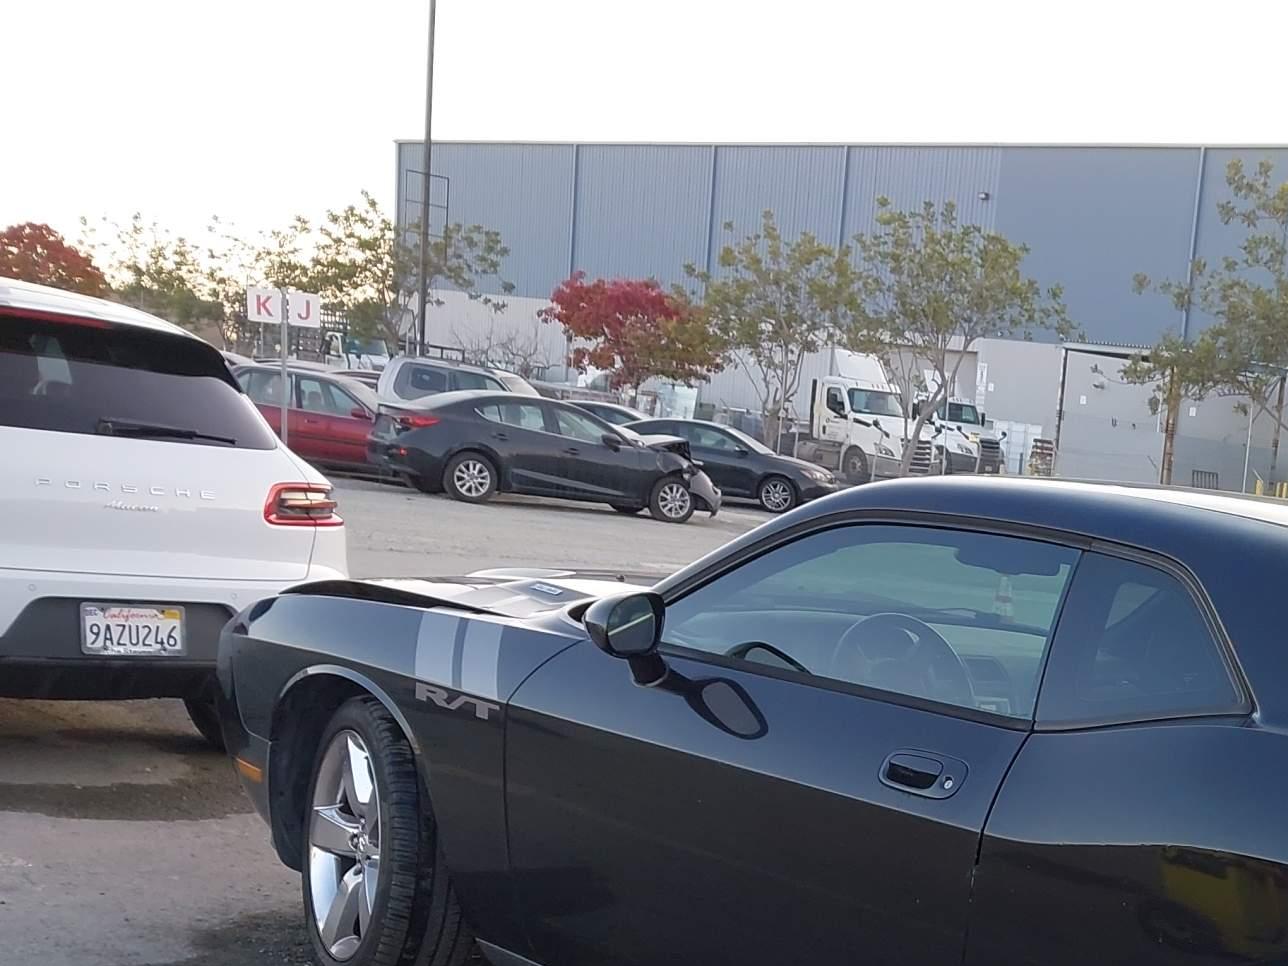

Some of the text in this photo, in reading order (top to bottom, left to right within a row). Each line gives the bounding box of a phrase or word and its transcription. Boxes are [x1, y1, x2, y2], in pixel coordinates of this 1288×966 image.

[256, 294, 274, 317] K
[297, 299, 311, 321] J
[34, 477, 217, 500] PORSCHE
[89, 623, 178, 649] 9AZU246
[415, 682, 500, 720] R/T
